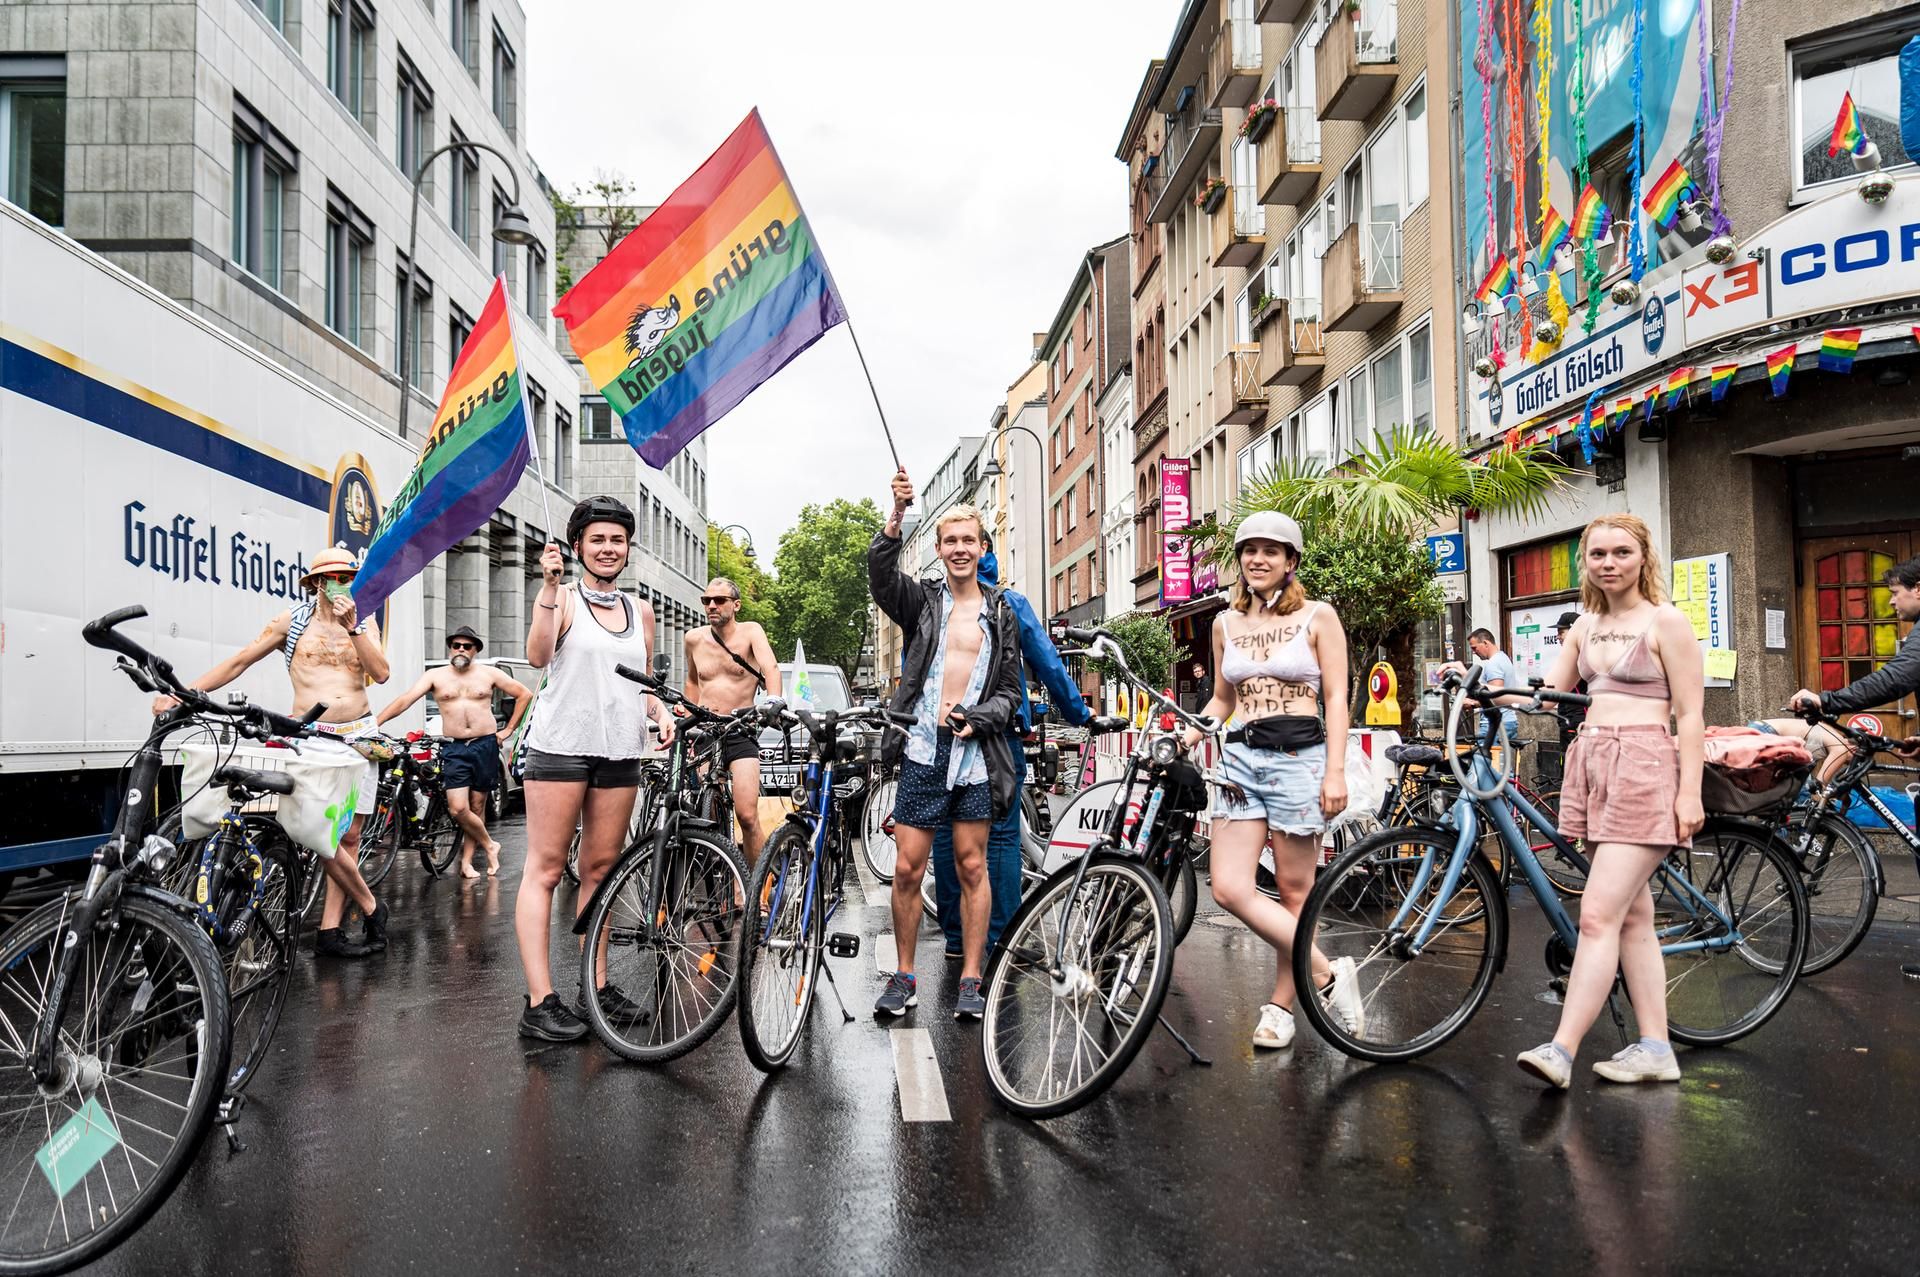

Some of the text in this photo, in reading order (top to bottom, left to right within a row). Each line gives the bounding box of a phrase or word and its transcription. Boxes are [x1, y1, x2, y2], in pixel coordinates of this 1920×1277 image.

[1516, 335, 1623, 415] Gaffel Kölsch
[1163, 463, 1188, 471] Gilden
[1164, 480, 1181, 494] die
[124, 500, 221, 585] Gaffel
[1708, 562, 1719, 648] CORNER
[1252, 648, 1269, 661] IS
[1869, 795, 1920, 848] PROPHETE
